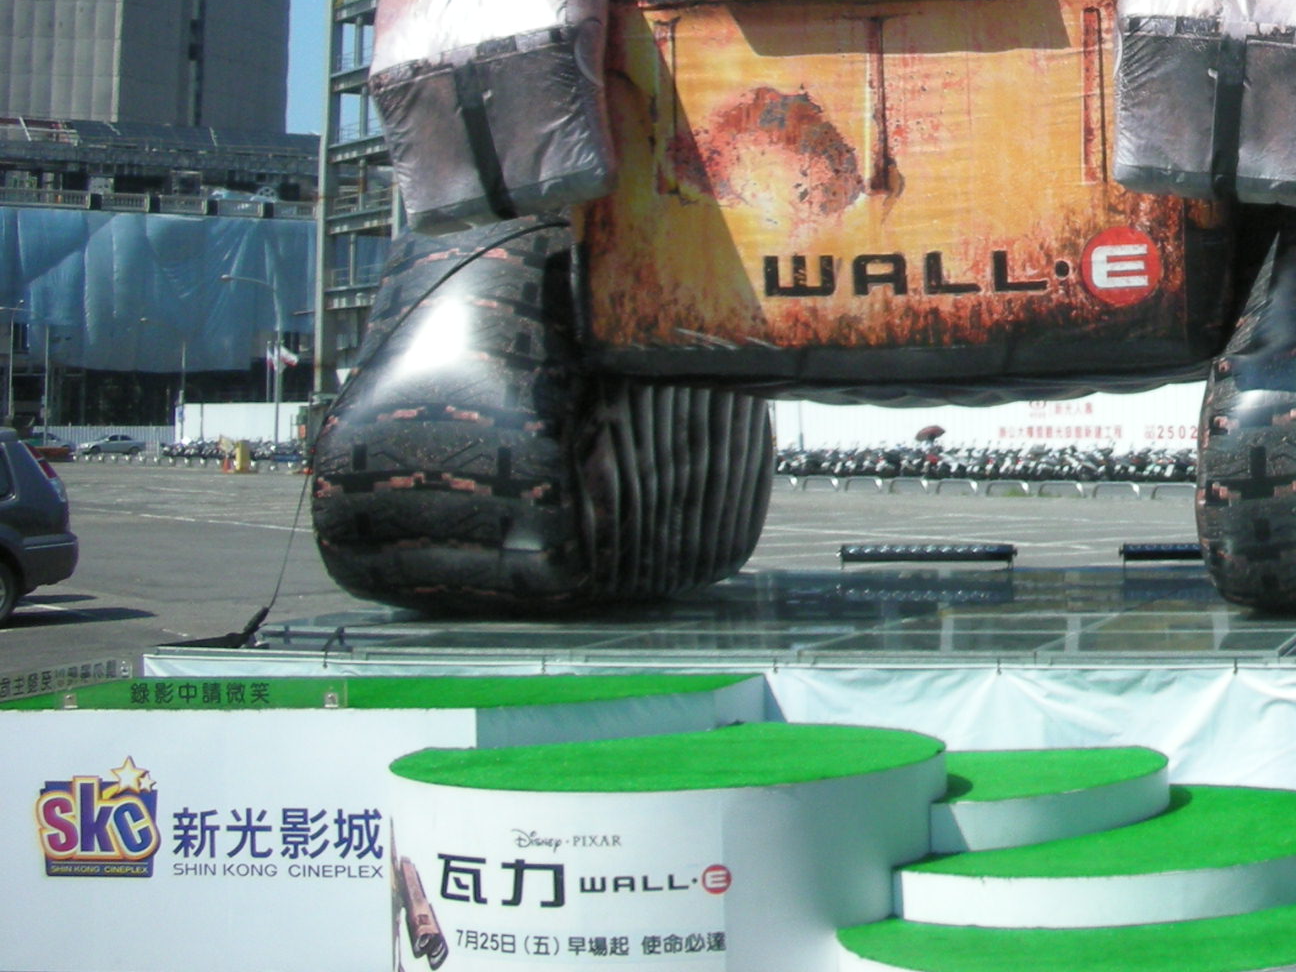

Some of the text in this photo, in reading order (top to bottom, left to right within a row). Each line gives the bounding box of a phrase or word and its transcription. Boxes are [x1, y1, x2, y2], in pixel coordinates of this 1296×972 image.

[130, 682, 270, 705] 錄影中請微笑
[172, 806, 384, 860] 新光影城
[573, 835, 622, 848] PIXAR
[103, 865, 149, 874] CINEPLEX
[172, 862, 385, 879] SHIN KONG CINEPLEX
[437, 853, 566, 908] 瓦力
[641, 930, 728, 954] 使命必達
